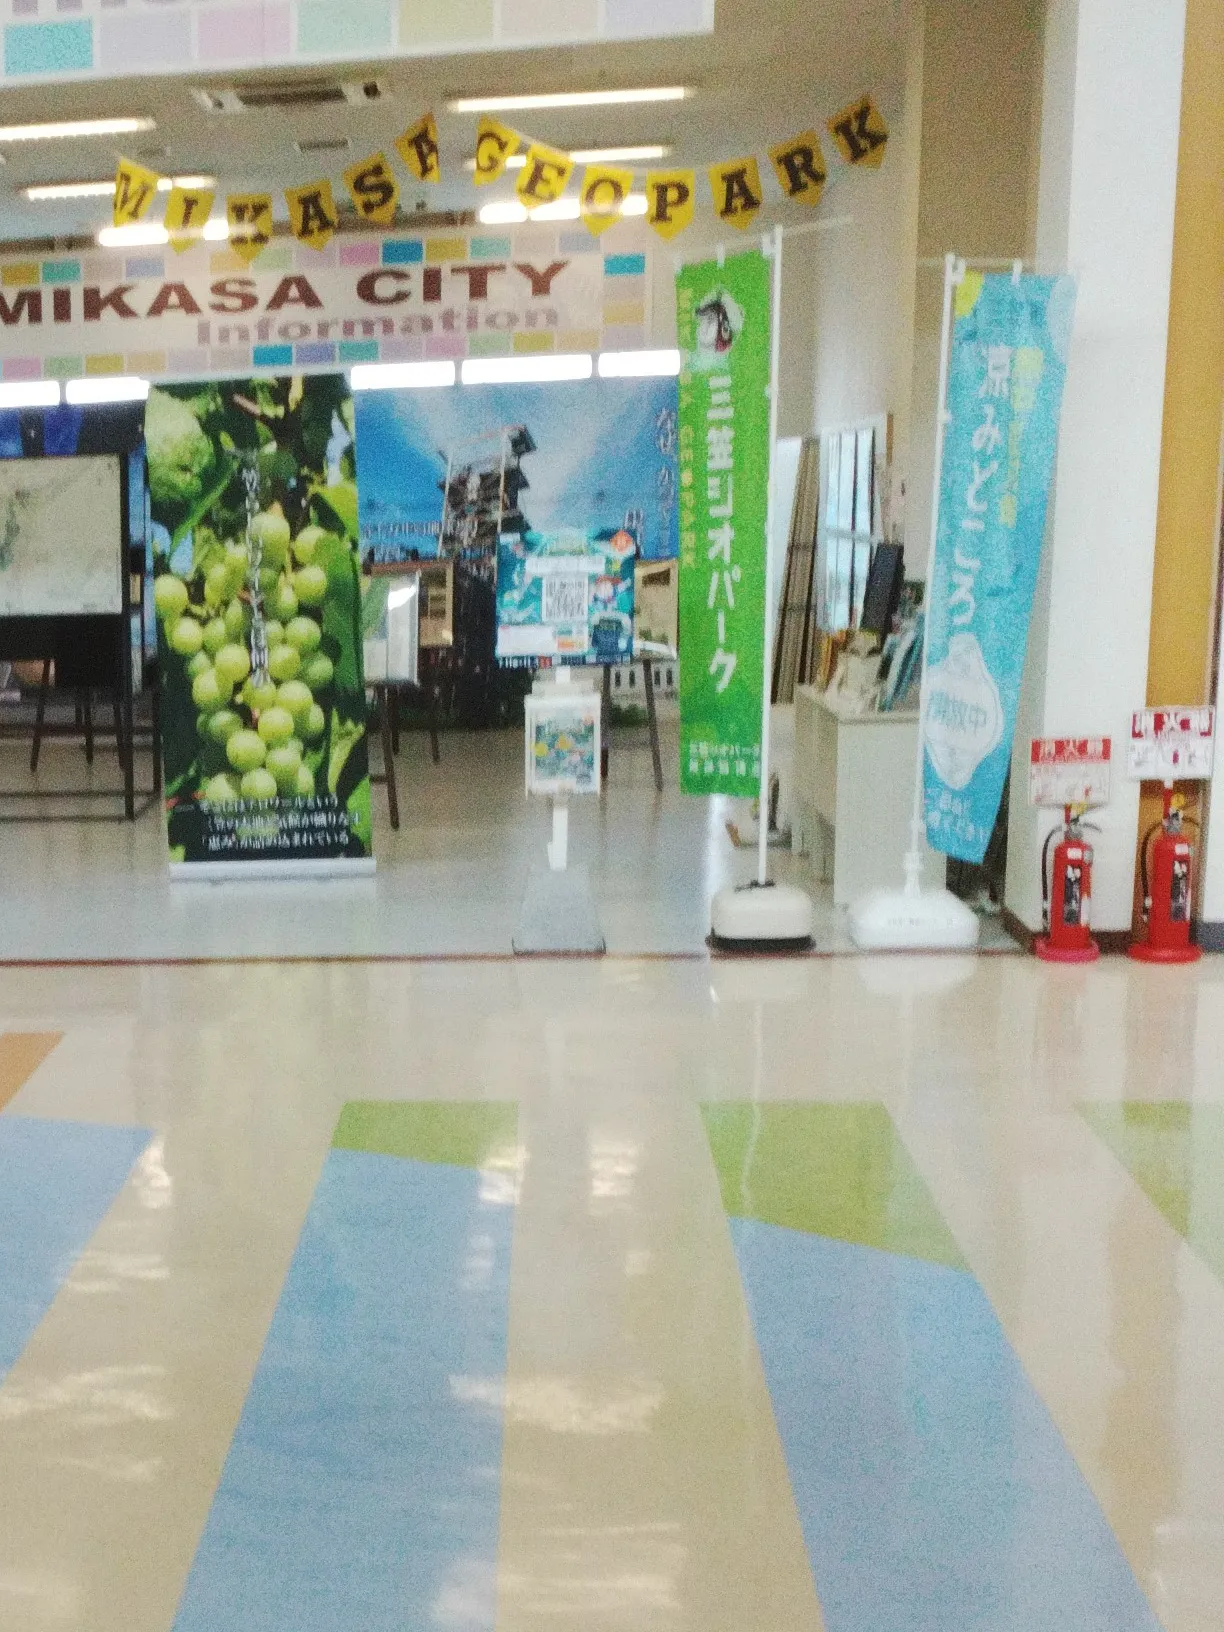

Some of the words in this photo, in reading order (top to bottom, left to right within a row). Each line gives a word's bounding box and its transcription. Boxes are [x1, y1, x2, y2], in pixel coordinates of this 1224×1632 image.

[114, 122, 438, 246] MIKASA
[476, 106, 889, 224] GEOPARK
[196, 300, 561, 347] Information
[356, 259, 571, 305] CITY
[705, 375, 742, 695] 三笠ジオパーク
